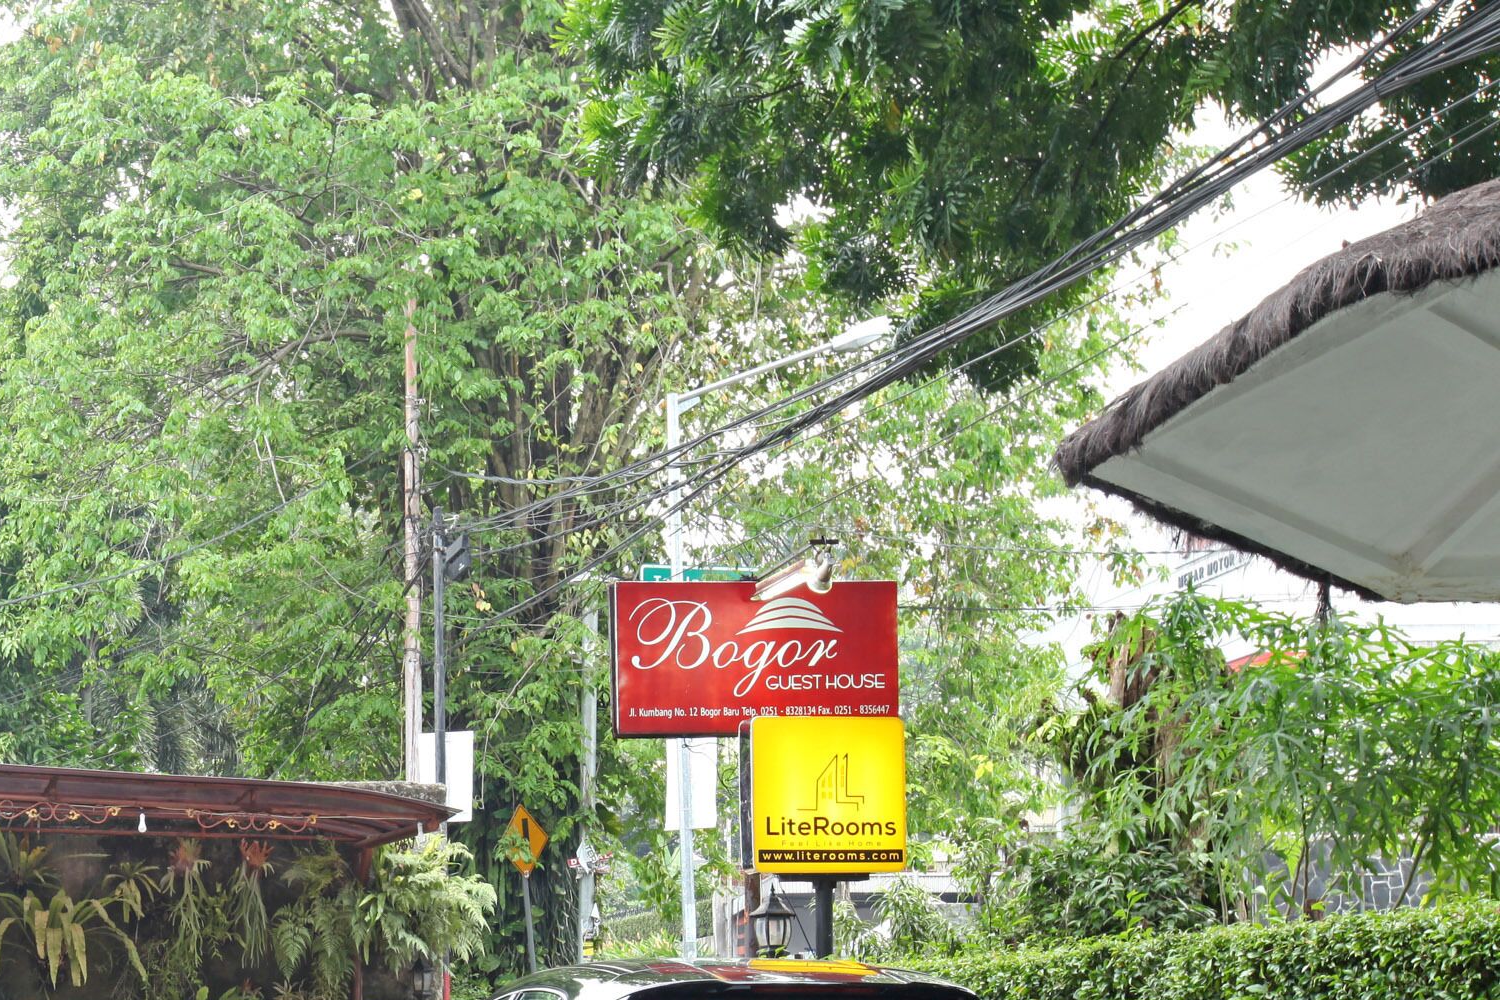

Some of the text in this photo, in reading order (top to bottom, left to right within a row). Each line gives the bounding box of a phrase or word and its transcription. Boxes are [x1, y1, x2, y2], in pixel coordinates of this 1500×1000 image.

[629, 598, 837, 697] Bogor
[765, 674, 885, 690] GUEST HOUSE
[629, 707, 637, 718] Jl.
[639, 707, 672, 718] Kumbang
[674, 707, 687, 717] No.
[689, 707, 698, 717] 12
[700, 707, 721, 718] Bogor
[723, 706, 740, 716] Baru
[741, 706, 758, 717] Telp.
[760, 706, 778, 716] 0251
[785, 705, 816, 716] 8328134
[818, 705, 832, 715] Fax.
[834, 705, 852, 715] 0251
[859, 704, 890, 714] 8356447
[766, 816, 897, 836] LiteRooms
[762, 850, 900, 861] www.literooms.com
